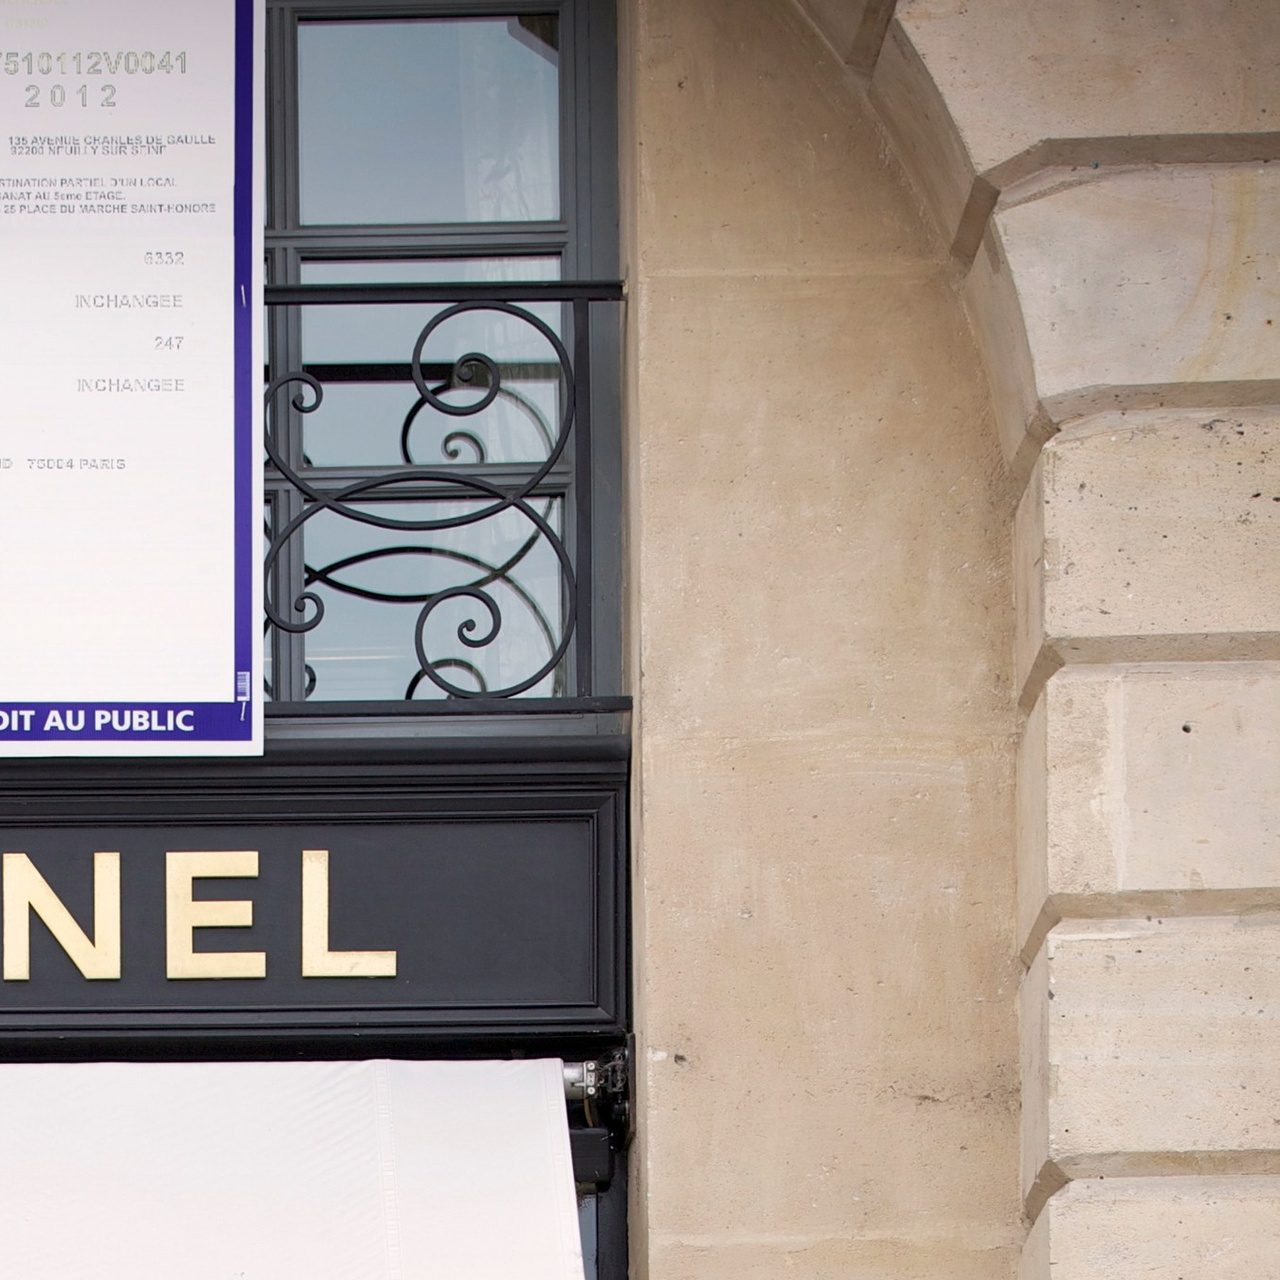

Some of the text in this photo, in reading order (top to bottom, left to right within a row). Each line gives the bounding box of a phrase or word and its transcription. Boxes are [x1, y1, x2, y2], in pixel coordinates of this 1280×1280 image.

[9, 134, 217, 147] 135 AVENUE CHARLES DE GAULLE
[102, 145, 128, 156] SUR
[35, 191, 50, 201] AU
[19, 204, 57, 214] PLACE
[60, 204, 75, 214] DU
[75, 294, 184, 309] INCHANGEE
[154, 336, 184, 351] 247
[77, 378, 185, 393] INCHANGEE
[79, 458, 126, 470] PARIS
[44, 710, 85, 732] AU
[95, 710, 194, 732] PUBLIC
